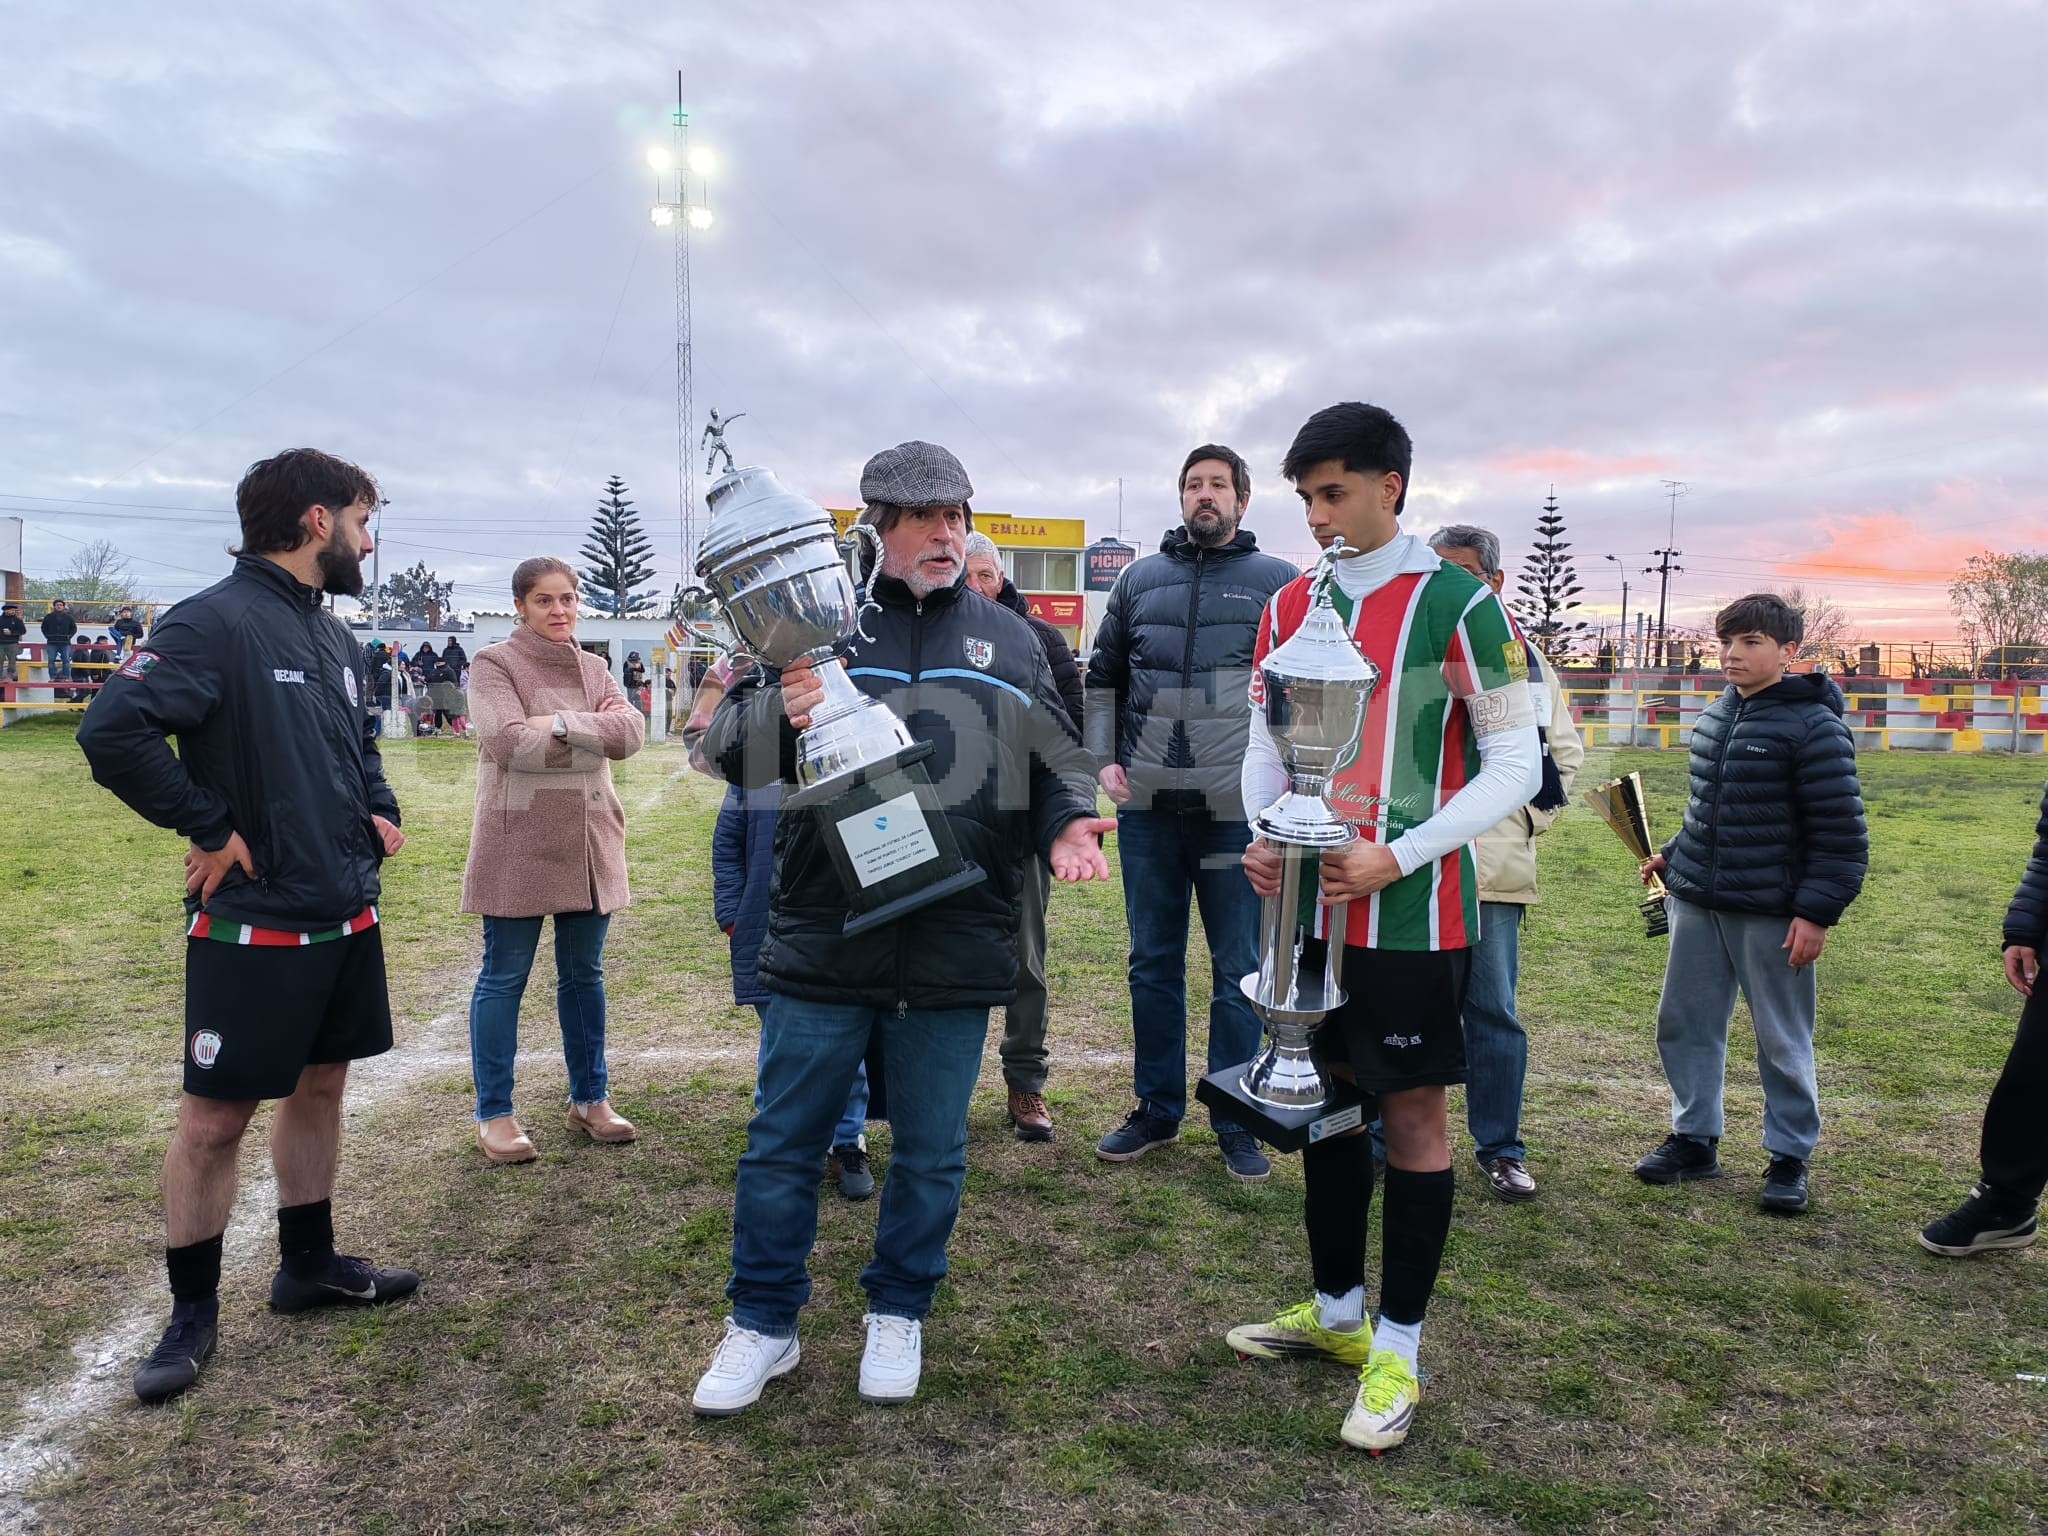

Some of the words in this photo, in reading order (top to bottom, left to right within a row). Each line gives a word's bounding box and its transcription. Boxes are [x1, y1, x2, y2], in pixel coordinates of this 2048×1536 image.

[990, 522, 1048, 536] EMILIA
[274, 669, 305, 684] DECANO
[1346, 815, 1404, 829] inistración
